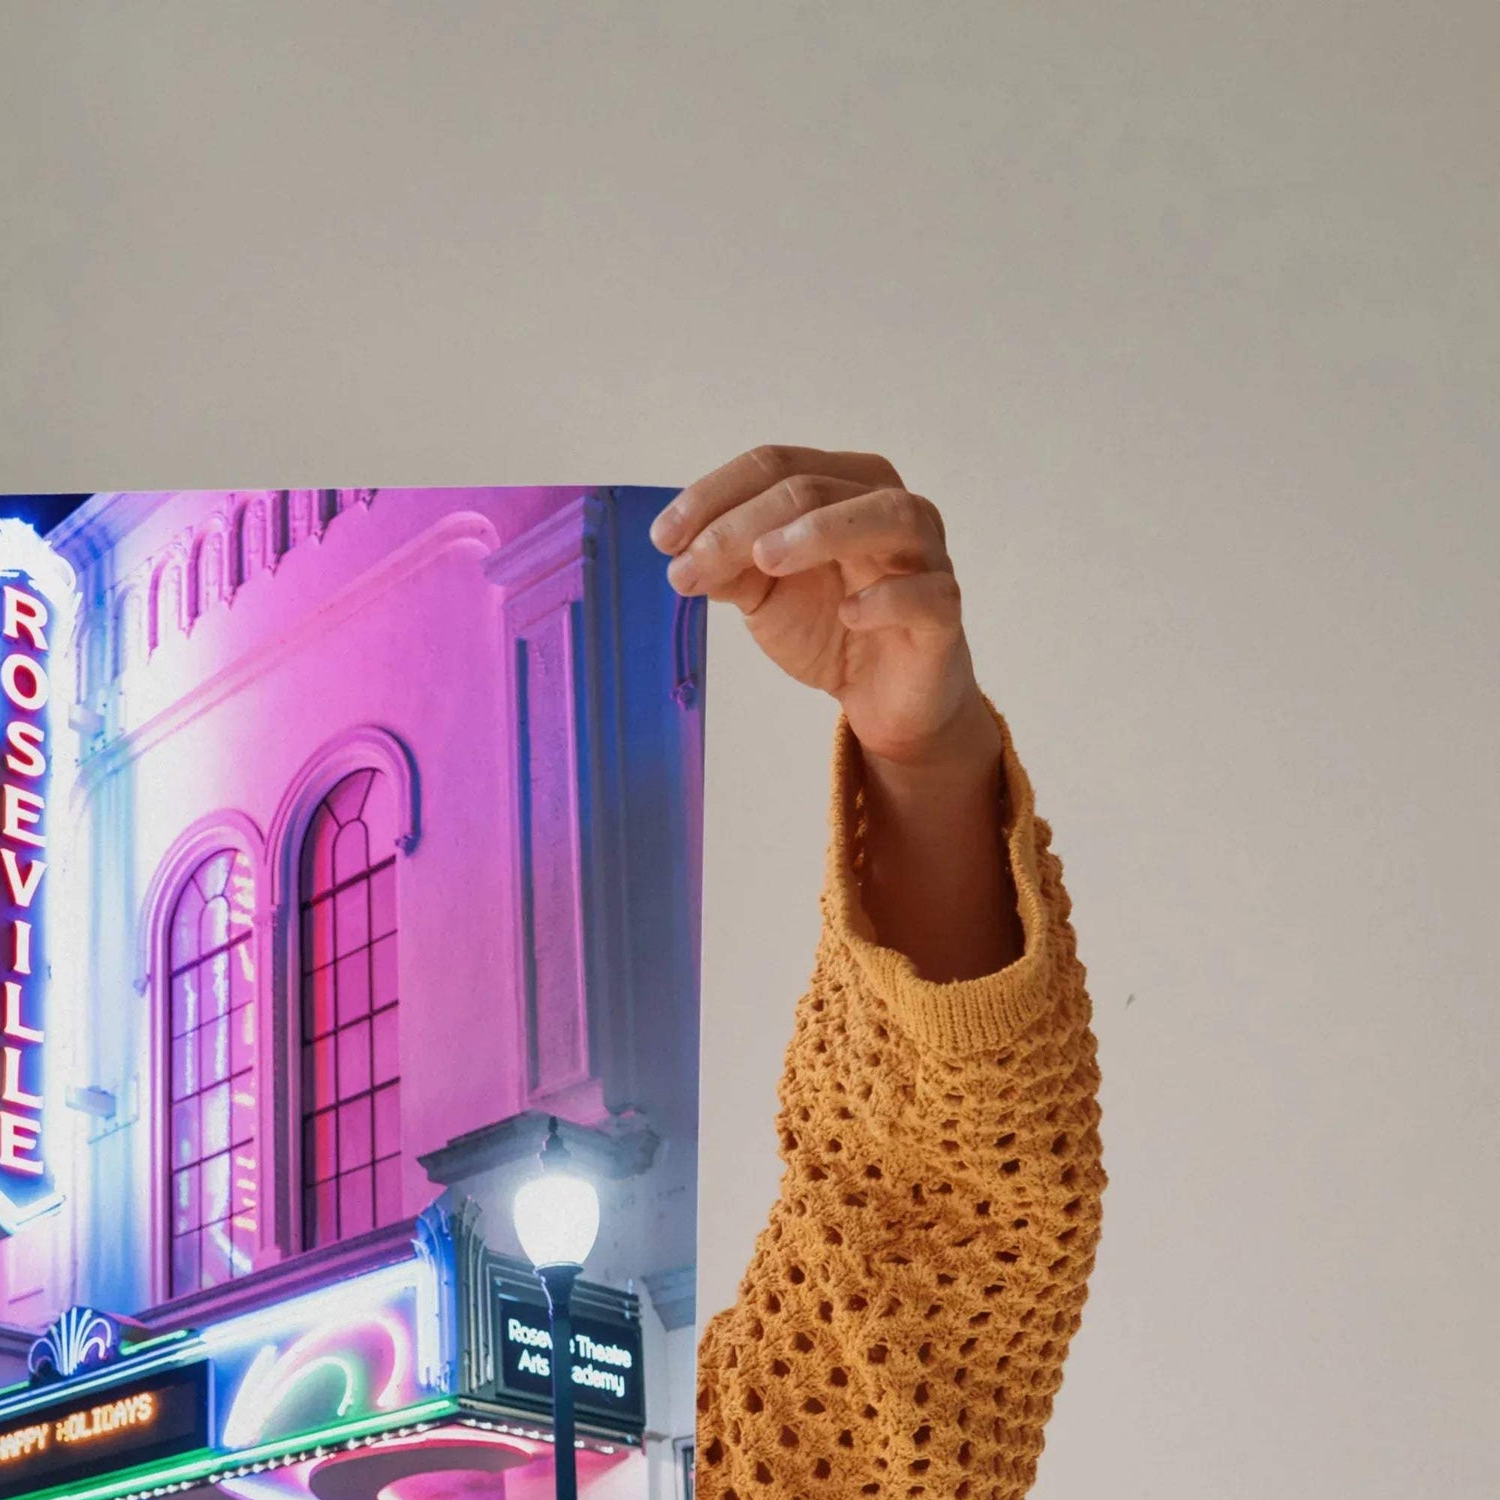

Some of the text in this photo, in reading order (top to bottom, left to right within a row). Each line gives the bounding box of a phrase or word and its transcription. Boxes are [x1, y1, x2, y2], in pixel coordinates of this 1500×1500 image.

[575, 1333, 633, 1369] Theatre
[517, 1348, 626, 1399] Arts ademy
